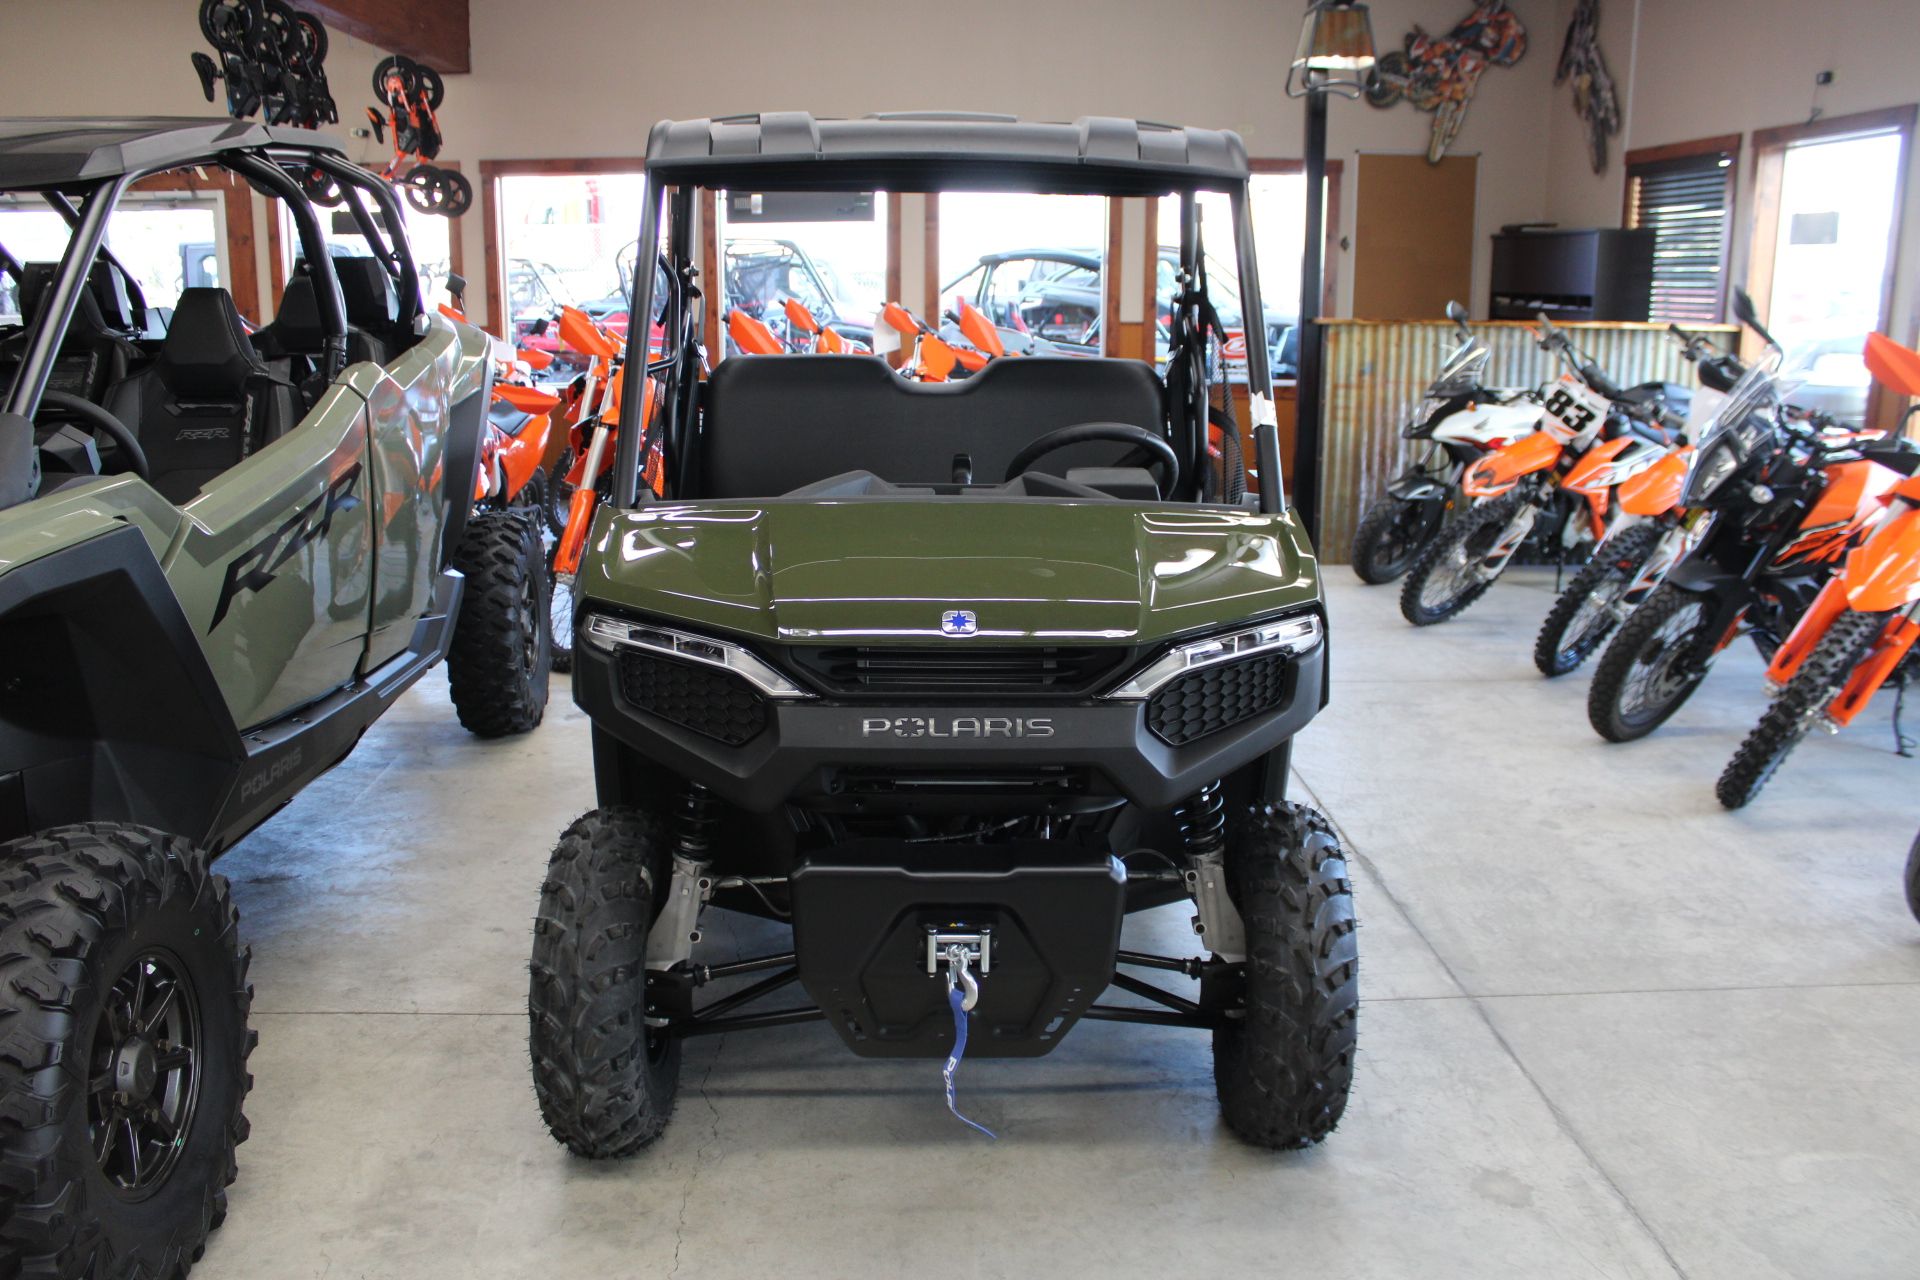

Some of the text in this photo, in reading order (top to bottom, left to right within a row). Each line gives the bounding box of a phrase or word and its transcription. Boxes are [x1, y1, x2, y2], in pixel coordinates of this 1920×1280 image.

[1546, 389, 1596, 432] 83
[175, 427, 231, 441] RZR
[207, 461, 363, 637] RZR
[862, 717, 1055, 738] POLARIS
[241, 747, 302, 804] POLARIS
